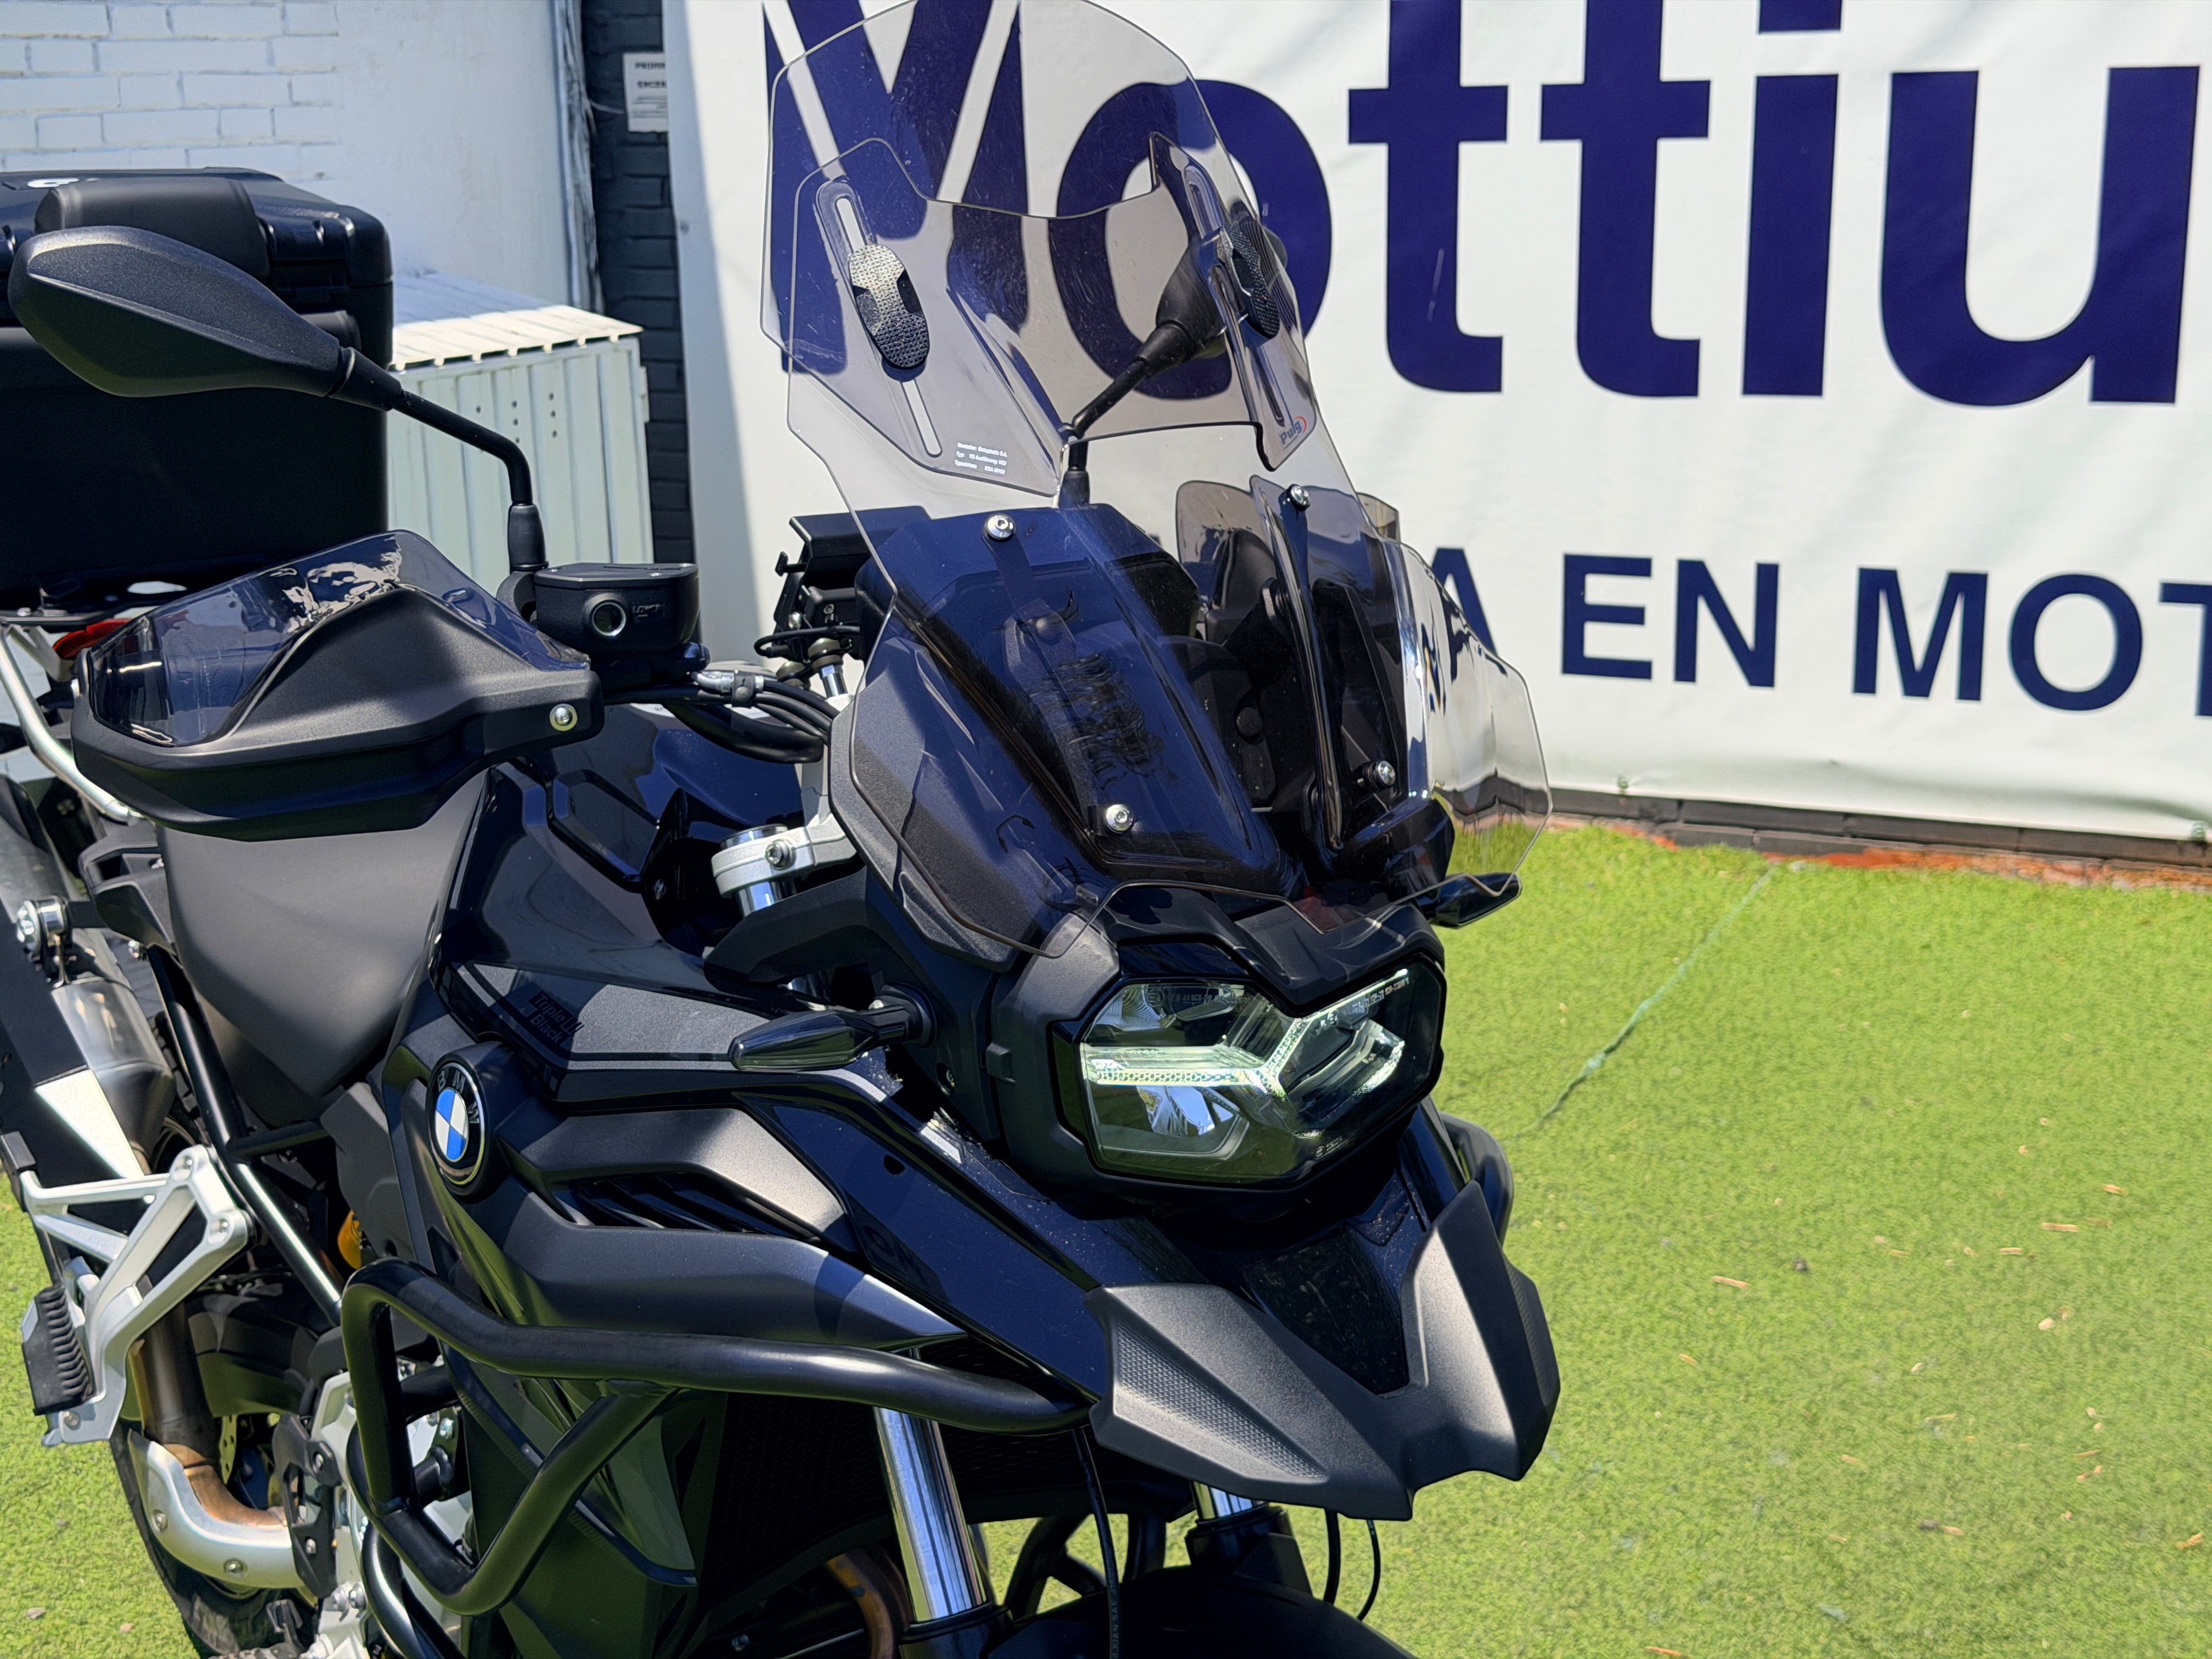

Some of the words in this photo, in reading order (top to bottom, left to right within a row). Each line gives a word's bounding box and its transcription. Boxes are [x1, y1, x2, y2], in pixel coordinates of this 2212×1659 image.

[1561, 553, 1780, 689] EN
[530, 1014, 563, 1043] Black
[534, 993, 566, 1023] Triple
[436, 1069, 480, 1125] BMW
